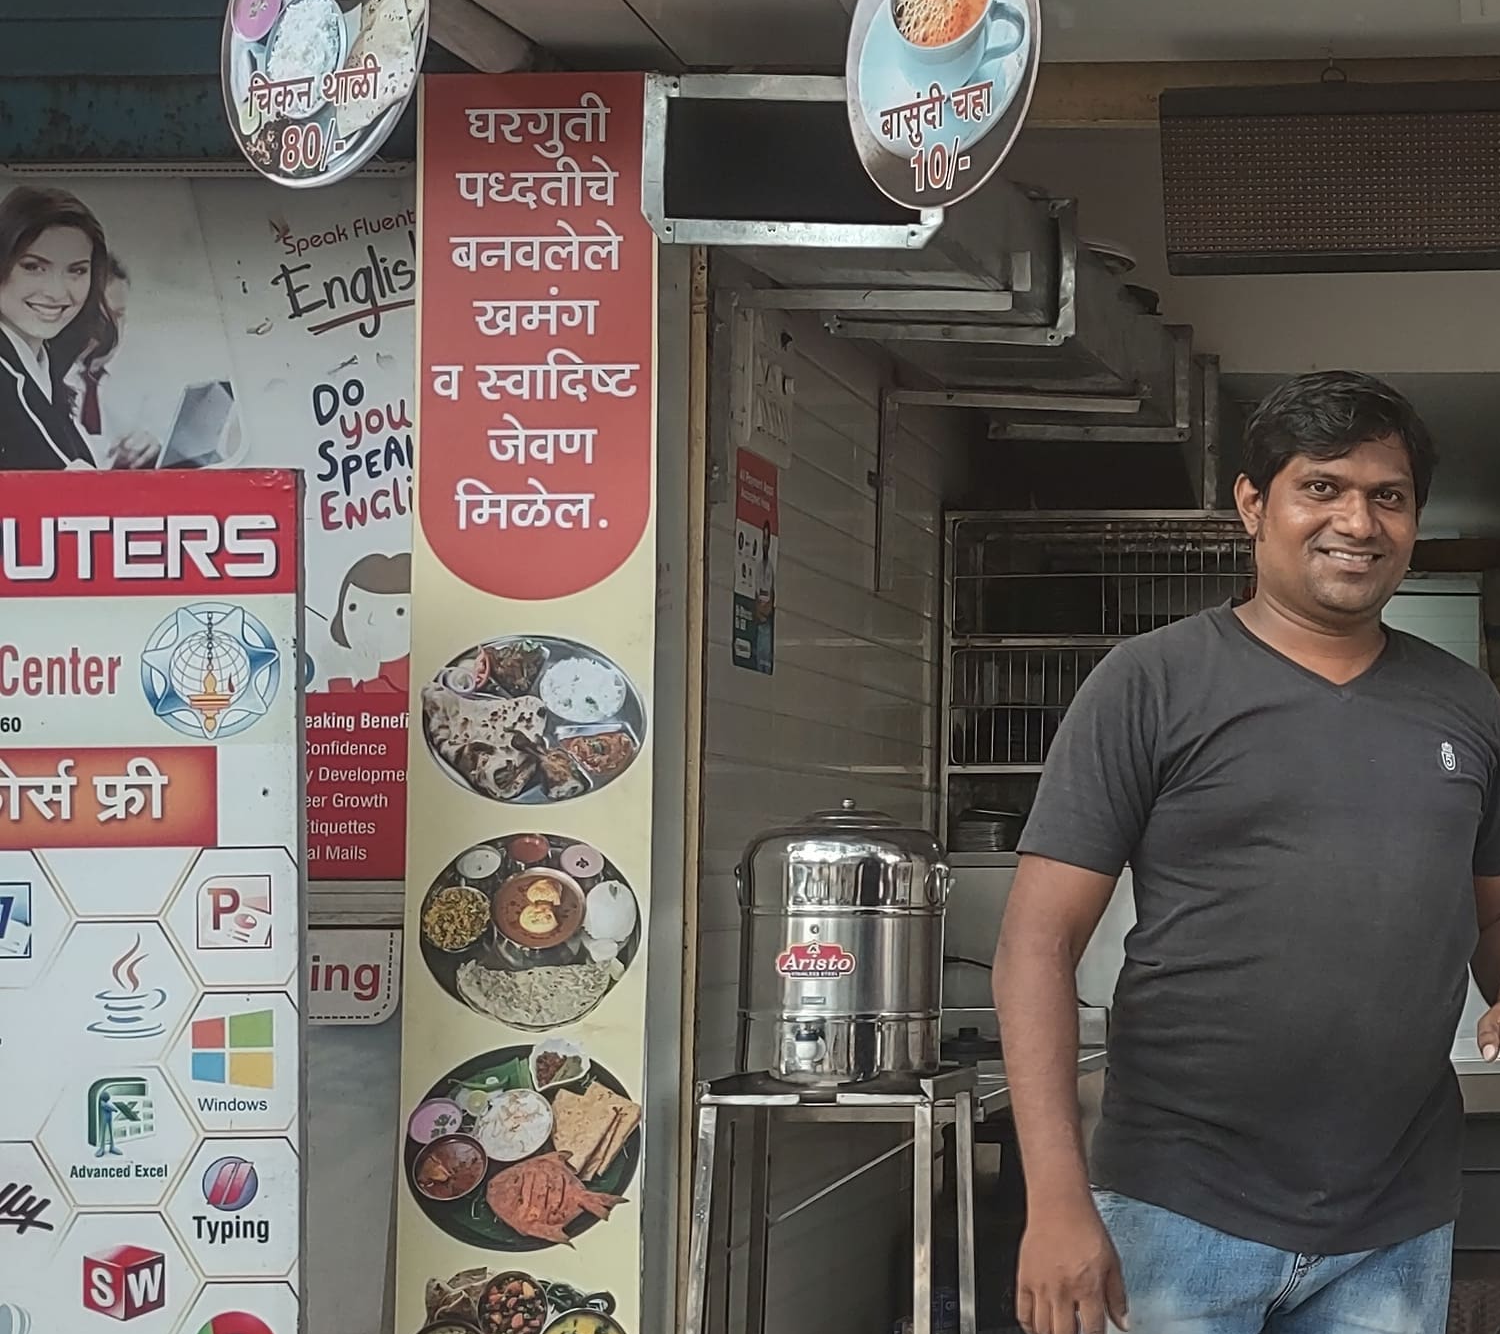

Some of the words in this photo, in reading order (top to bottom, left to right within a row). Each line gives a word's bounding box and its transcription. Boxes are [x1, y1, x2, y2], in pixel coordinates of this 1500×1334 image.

[248, 72, 315, 117] चिकन
[321, 52, 382, 102] थाळी
[465, 92, 612, 158] घरगुती
[880, 82, 946, 148] बासुंदी
[951, 80, 994, 123] चहा
[280, 119, 347, 172] 80/-
[910, 137, 971, 193] 10/-
[456, 156, 620, 210] पध्दतीचे
[283, 221, 349, 255] Speak
[353, 209, 416, 239] Fluent
[449, 220, 624, 272] बनवलेले
[473, 286, 600, 337] खमंग
[431, 364, 464, 402] व
[475, 347, 640, 403] स्वादिष्ट
[487, 413, 599, 466] जेवण
[454, 477, 610, 531] मिळेल.
[1, 514, 278, 581] UTERS
[0, 644, 122, 697] Center
[0, 757, 77, 823] ोर्स
[92, 756, 169, 823] फ्री
[332, 792, 388, 809] Growth
[325, 844, 367, 861] Mails
[781, 952, 852, 972] Aristo
[197, 1097, 268, 1113] Windows
[70, 1164, 131, 1180] Advanced
[134, 1163, 168, 1179] Excel
[192, 1215, 271, 1245] Typing
